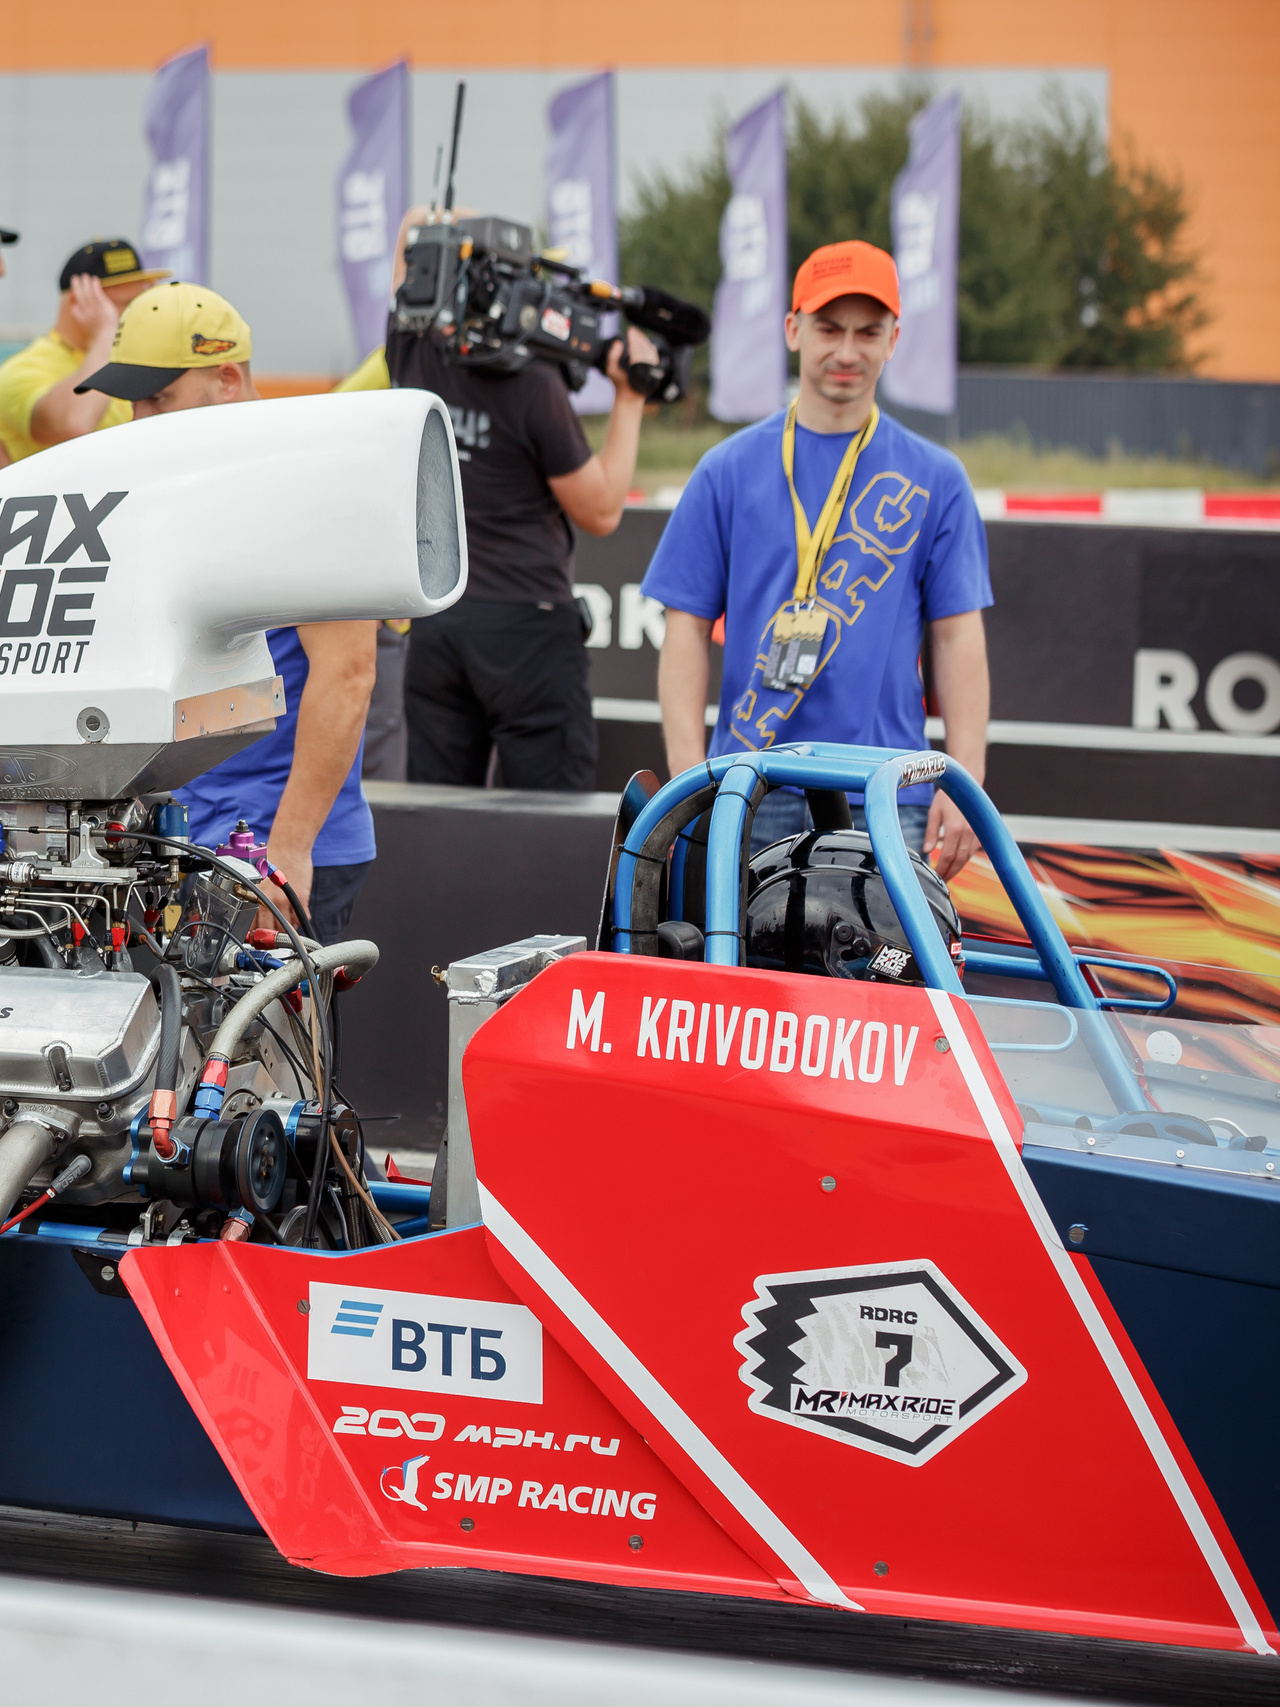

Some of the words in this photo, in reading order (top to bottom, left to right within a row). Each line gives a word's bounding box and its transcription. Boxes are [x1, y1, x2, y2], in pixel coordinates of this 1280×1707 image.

[0, 786, 85, 800] TECHNOLOGY
[875, 956, 906, 973] RIDE
[881, 945, 912, 963] MAX
[566, 988, 612, 1054] M.
[637, 996, 919, 1086] KRIVOBOKOV
[860, 1304, 918, 1325] RDRC
[391, 1319, 507, 1381] ВТБ
[875, 1331, 913, 1388] 7
[794, 1387, 841, 1414] MR
[332, 1405, 446, 1441] 200
[846, 1408, 952, 1423] MOTORSPORT
[432, 1472, 512, 1505] SMP
[518, 1480, 657, 1520] RACING
